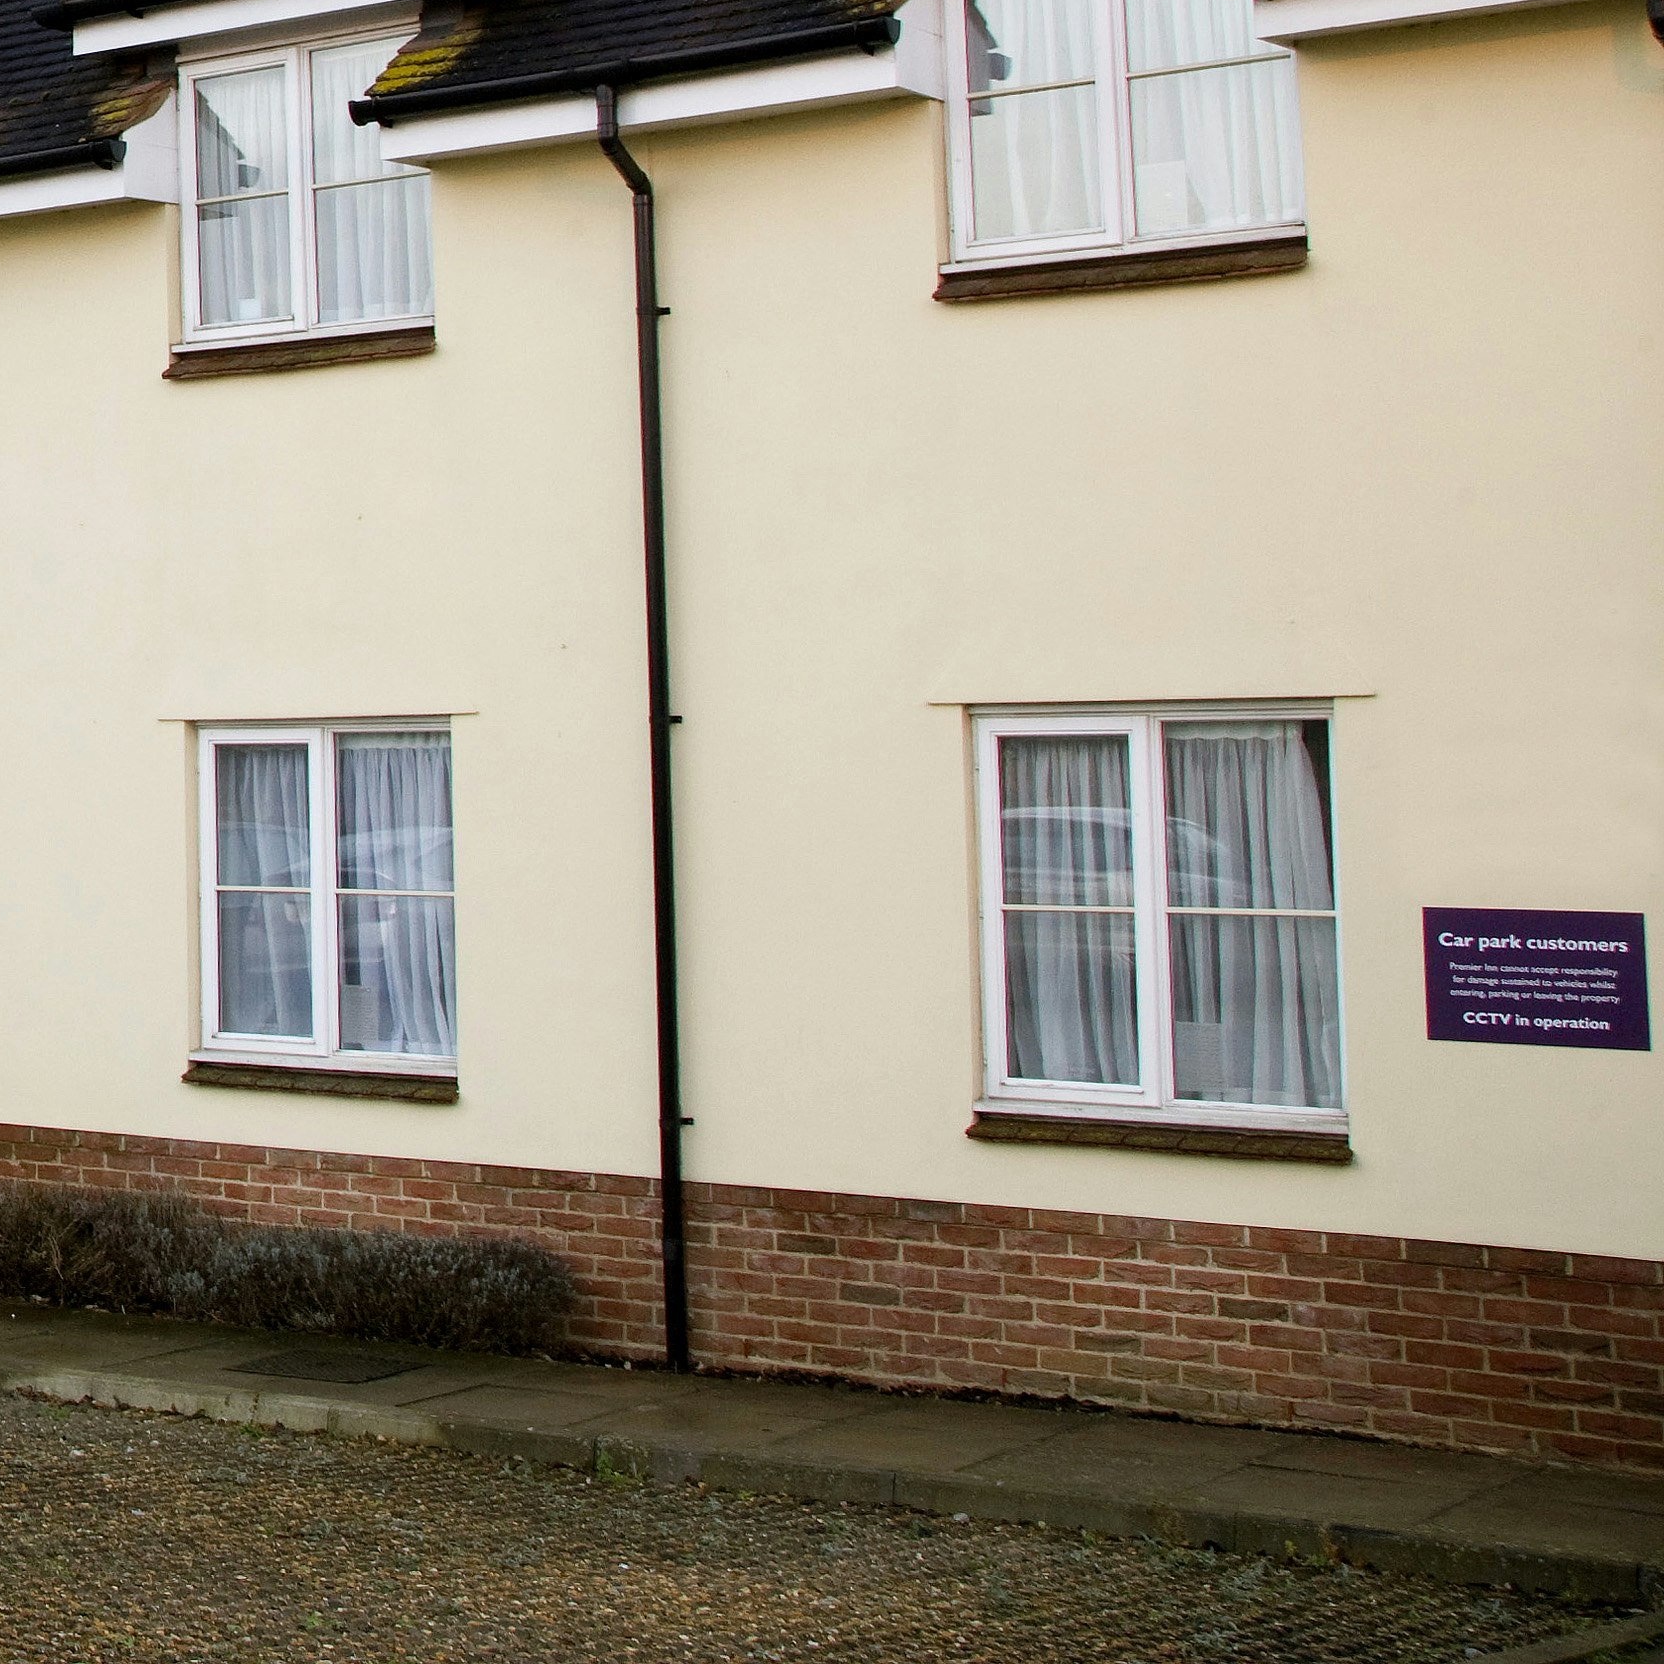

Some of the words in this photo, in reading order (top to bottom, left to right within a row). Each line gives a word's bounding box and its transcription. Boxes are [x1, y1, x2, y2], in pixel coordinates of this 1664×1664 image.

[1438, 932, 1474, 947] Car
[1478, 934, 1521, 952] park
[1526, 937, 1629, 953] customers
[1449, 961, 1483, 971] Premier
[1484, 963, 1498, 972] Inn
[1500, 964, 1529, 973] cannot
[1530, 966, 1560, 976] accept
[1561, 967, 1618, 978] responsibility
[1452, 974, 1465, 983] for
[1467, 975, 1499, 986] damage
[1501, 977, 1540, 986] sustained
[1553, 979, 1588, 989] vehicles
[1589, 980, 1616, 989] whilst
[1488, 989, 1520, 1001] parking
[1533, 991, 1564, 1002] leaving
[1564, 992, 1579, 1001] the
[1462, 1011, 1512, 1025] CCTV
[1515, 1014, 1530, 1027] in
[1533, 1017, 1611, 1031] operation
